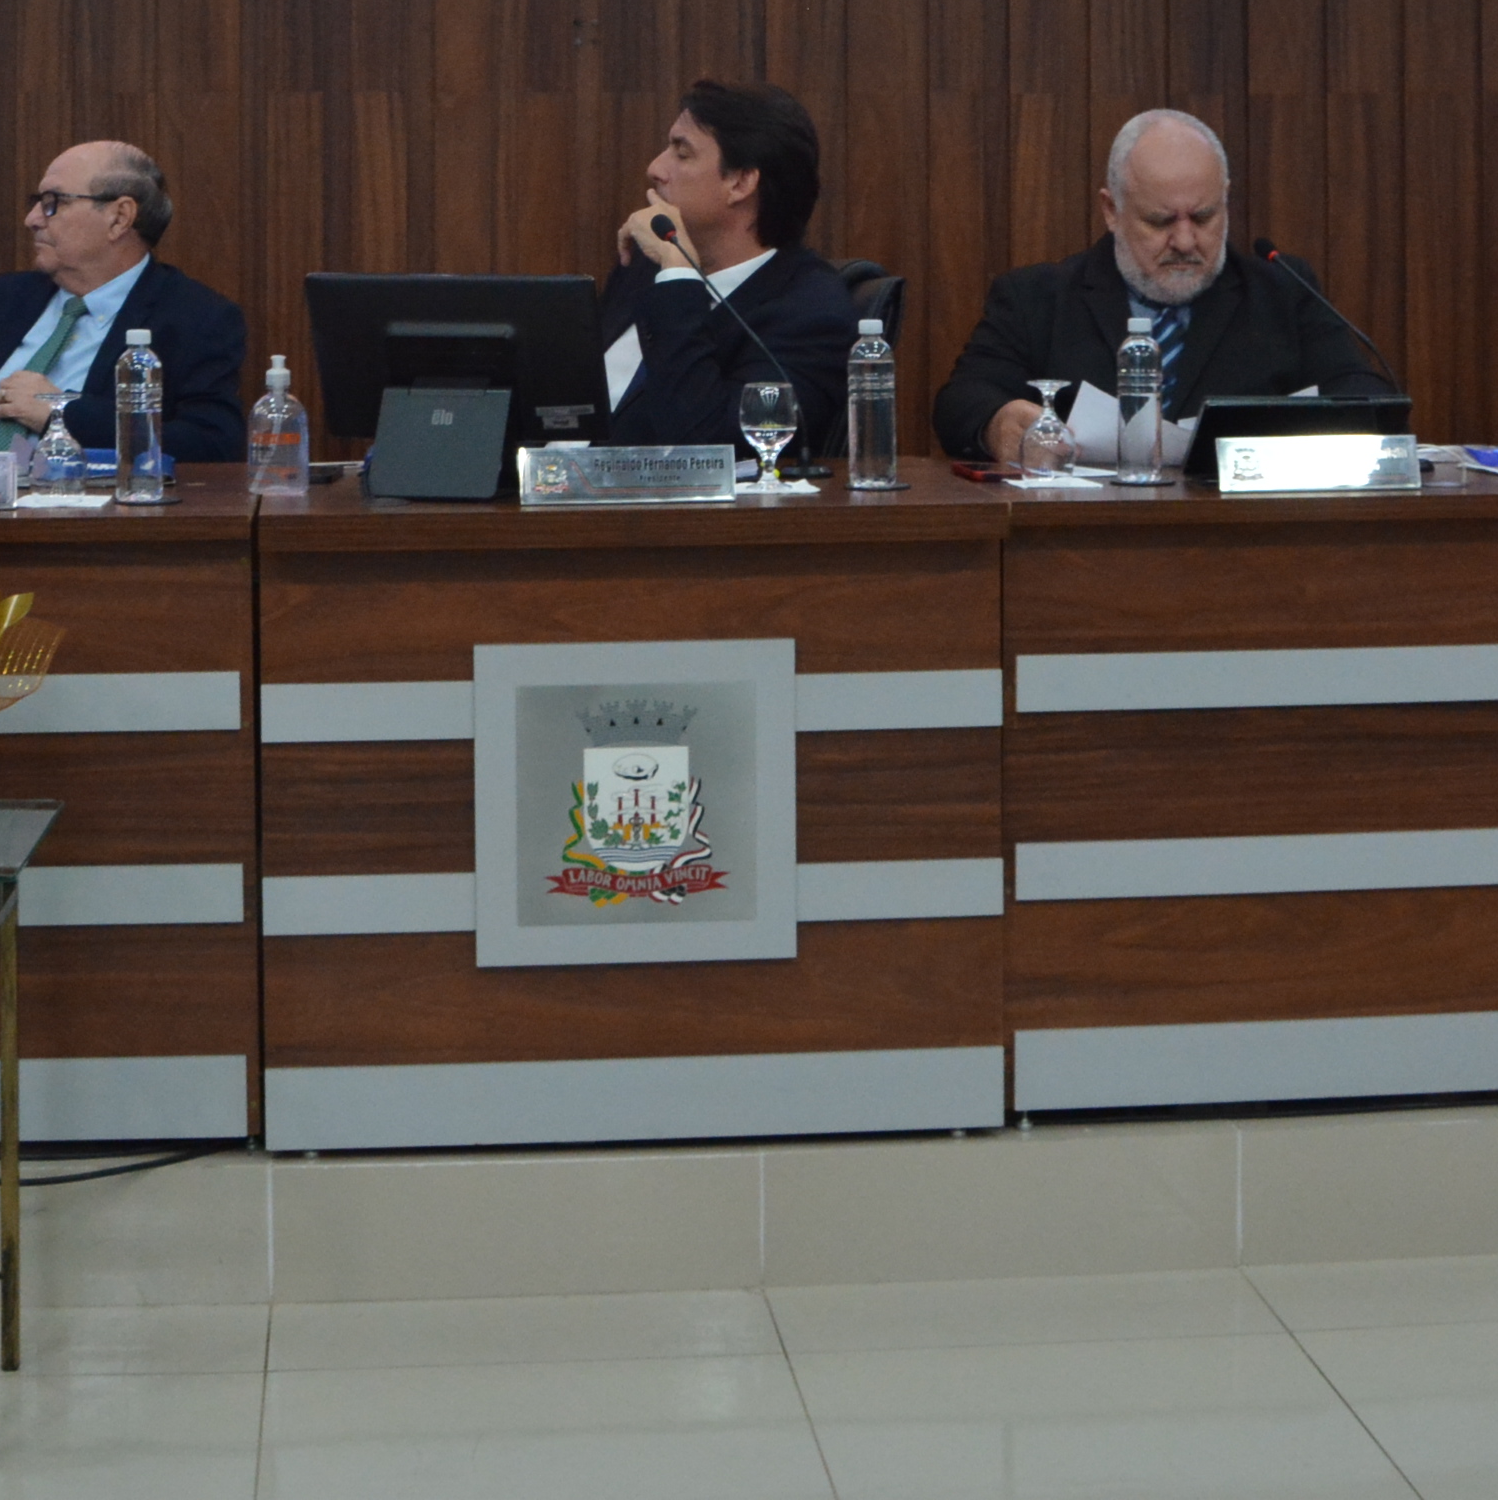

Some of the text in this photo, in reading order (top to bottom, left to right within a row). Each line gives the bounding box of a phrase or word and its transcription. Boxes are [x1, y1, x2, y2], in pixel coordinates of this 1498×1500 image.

[568, 866, 709, 891] LABOR OMNIA VINCIT
